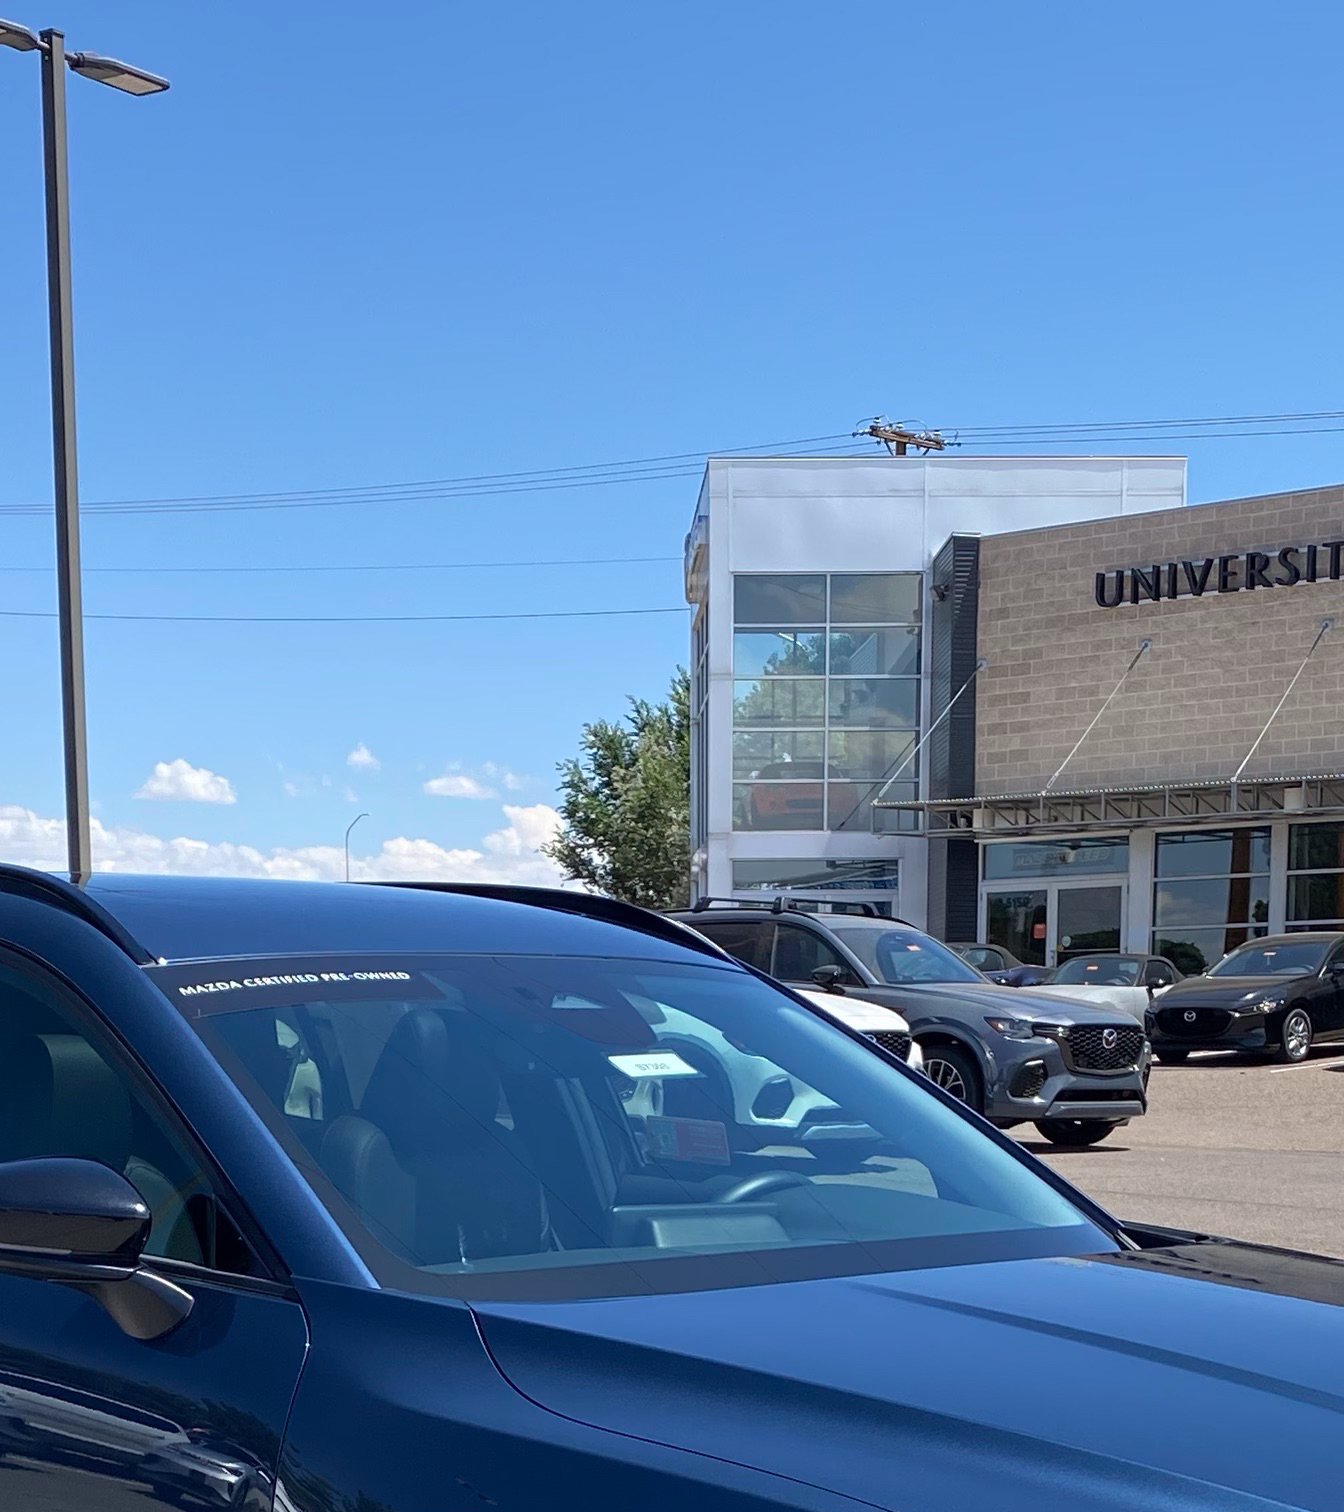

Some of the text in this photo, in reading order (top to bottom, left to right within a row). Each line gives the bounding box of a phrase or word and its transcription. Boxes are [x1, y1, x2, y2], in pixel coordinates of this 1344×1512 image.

[178, 971, 411, 996] MAZDA CERTIFIED PRE-OWNED
